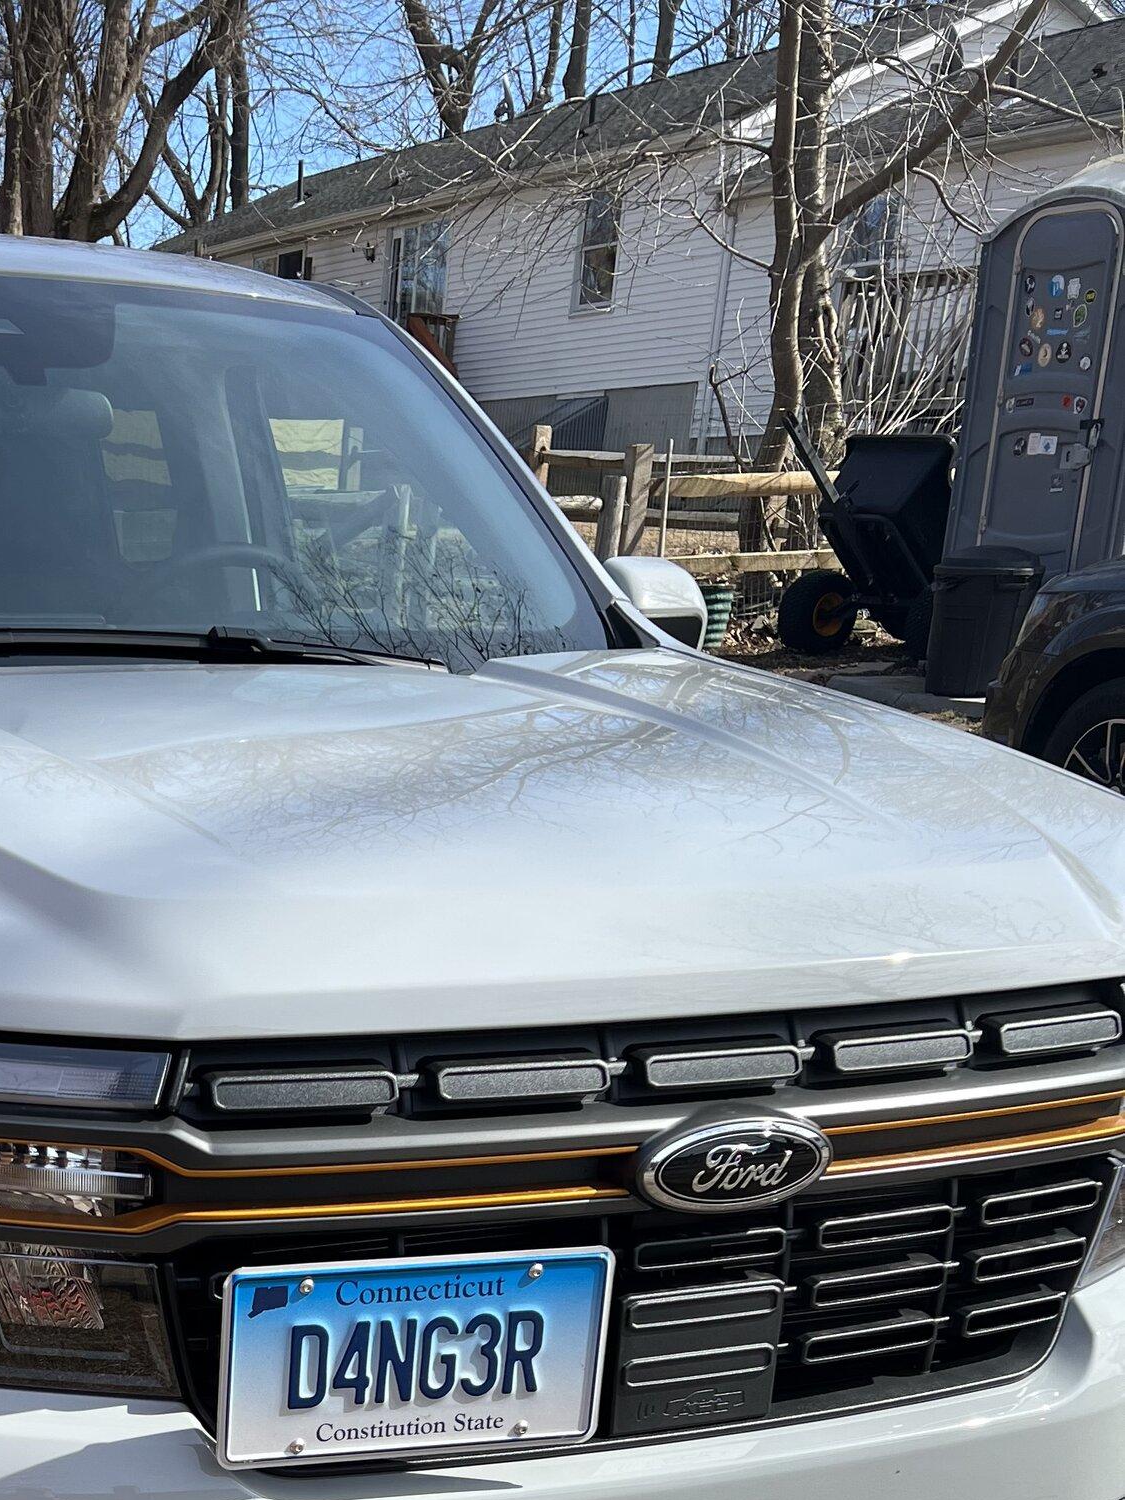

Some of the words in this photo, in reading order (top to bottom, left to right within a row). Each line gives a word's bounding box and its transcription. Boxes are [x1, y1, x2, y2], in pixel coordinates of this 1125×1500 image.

[692, 1142, 793, 1193] Ford
[335, 1274, 506, 1307] Connecticut
[288, 1309, 545, 1410] D4NG3R
[316, 1416, 446, 1443] Constitution
[453, 1412, 504, 1433] State
